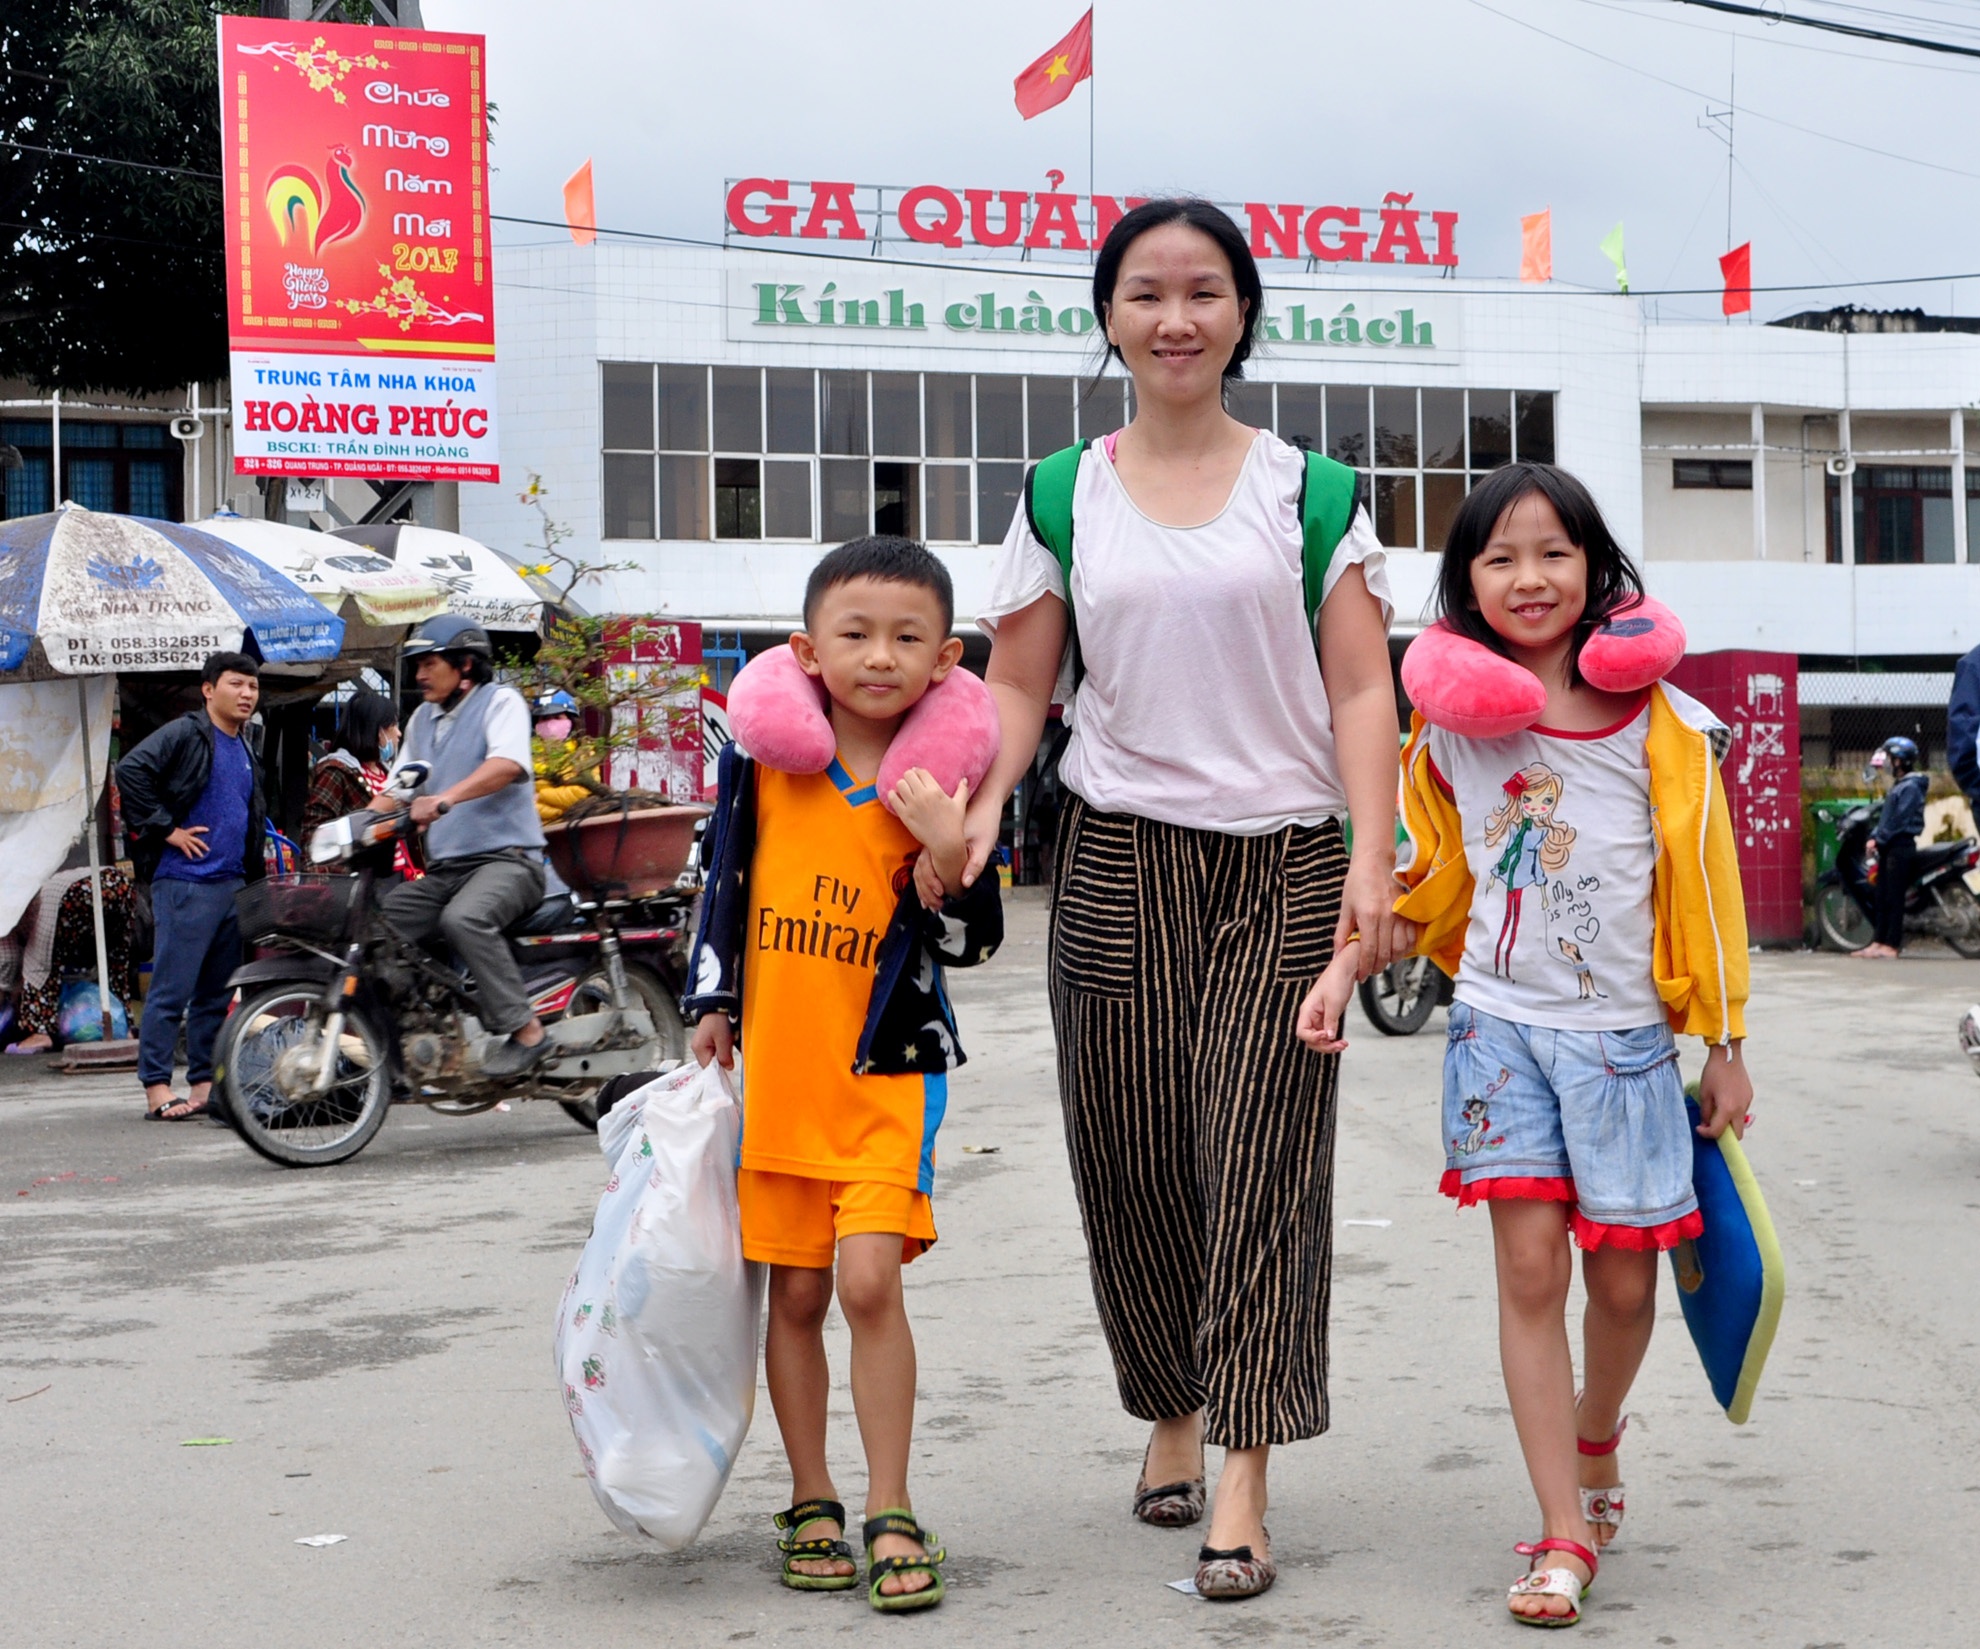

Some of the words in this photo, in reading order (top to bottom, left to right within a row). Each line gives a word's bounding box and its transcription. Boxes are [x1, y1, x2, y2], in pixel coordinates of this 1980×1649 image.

[385, 169, 452, 195] Năm
[393, 213, 452, 238] Mới
[726, 177, 866, 240] GA
[1245, 191, 1458, 266] NGÃI
[393, 244, 458, 273] 2017
[284, 262, 325, 283] Happy
[752, 282, 928, 330] Kính
[944, 290, 1095, 335] chào
[254, 369, 321, 387] TRUNG
[327, 367, 371, 388] TÂM
[378, 374, 417, 390] NHA
[424, 376, 476, 392] KHOA
[244, 393, 379, 435] HOÀNG
[388, 398, 488, 439] PHÚC
[374, 442, 409, 456] ĐÌNH
[415, 443, 469, 458] HOÀNG
[148, 600, 212, 613] TRANG
[67, 638, 89, 651] ĐT
[110, 636, 221, 650] 058.3826351
[69, 653, 106, 666] FAX:
[813, 874, 861, 914] Fly
[1552, 880, 1574, 903] My
[1577, 874, 1600, 892] dog
[1547, 909, 1561, 922] is
[1567, 900, 1591, 917] my
[758, 907, 882, 969] Emirat
